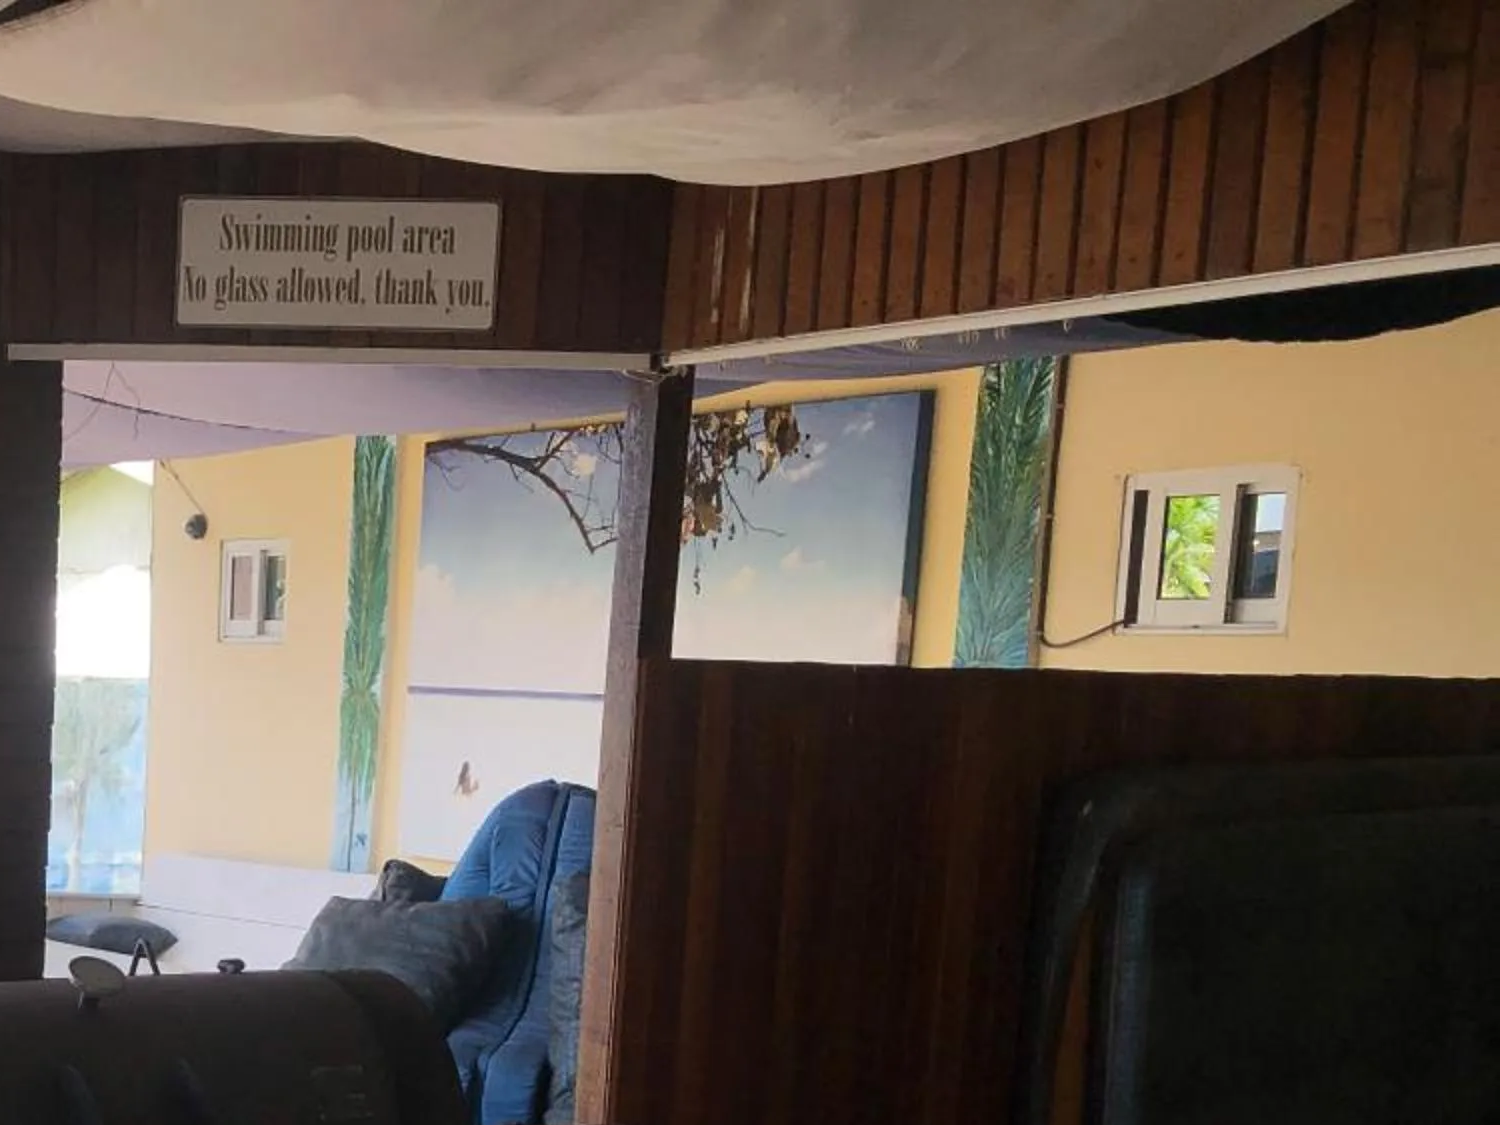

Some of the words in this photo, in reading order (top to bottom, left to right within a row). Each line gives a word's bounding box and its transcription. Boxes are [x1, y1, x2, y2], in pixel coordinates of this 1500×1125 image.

[219, 213, 338, 261] Swimming
[347, 215, 395, 263] pool
[403, 224, 456, 255] area
[183, 265, 206, 303] No
[214, 265, 268, 311] glass
[375, 268, 438, 305] thank
[444, 278, 490, 314] you.
